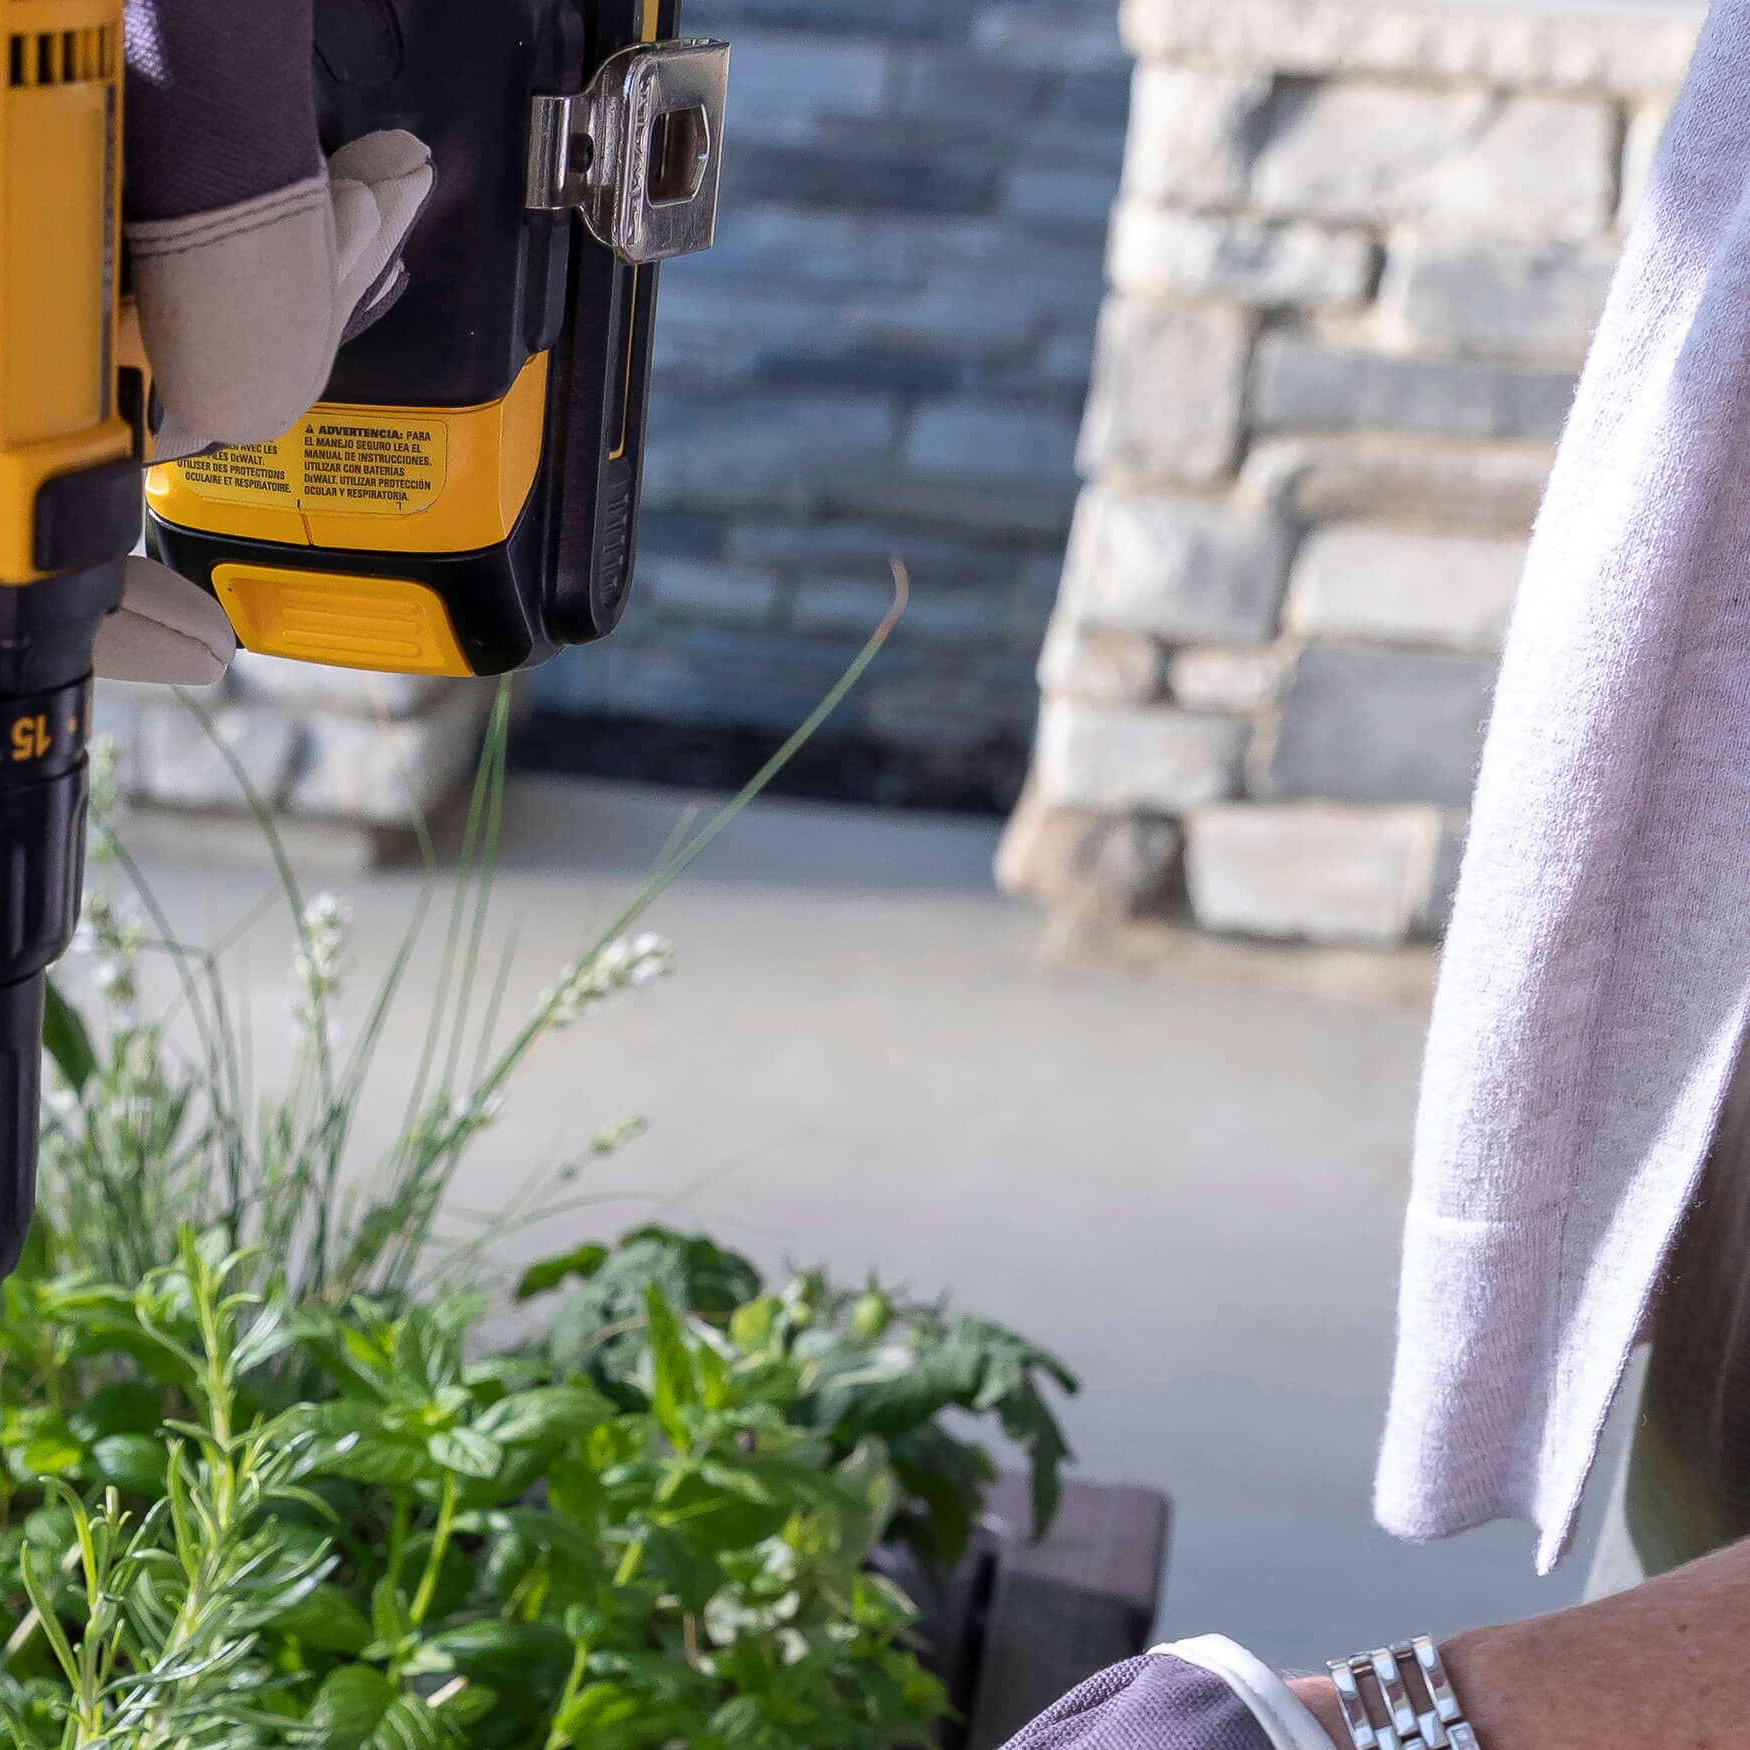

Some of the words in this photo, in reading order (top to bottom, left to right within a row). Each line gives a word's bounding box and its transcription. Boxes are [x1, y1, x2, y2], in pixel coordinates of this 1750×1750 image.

[319, 425, 403, 440] ADVERTENCIA:
[406, 431, 432, 441] PARA
[263, 445, 278, 455] LES
[304, 436, 314, 446] EL
[316, 438, 354, 449] MANEJO
[356, 440, 392, 451] SEGURO
[393, 442, 410, 453] LEA
[411, 443, 422, 453] EL
[304, 448, 342, 460] MANUAL
[344, 451, 356, 462] DE
[358, 453, 432, 466] INSTRUCCIONES.
[177, 460, 211, 471] UTILISER
[212, 463, 228, 473] DES
[230, 465, 285, 480] PROTECTIONS
[304, 461, 342, 473] UTILIZAR
[343, 464, 361, 474] CON
[363, 465, 405, 477] BATERÍAS
[185, 471, 222, 485] OCULAIRE
[223, 476, 233, 485] ET
[234, 477, 291, 493] RESPIRATOIRE.
[339, 476, 377, 487] UTILIZAR
[378, 478, 431, 490] PROTECCIÓN
[304, 485, 337, 496] OCULAR
[339, 487, 346, 497] Y
[347, 488, 410, 501] RESPIRATORIA.
[10, 714, 52, 762] 15
